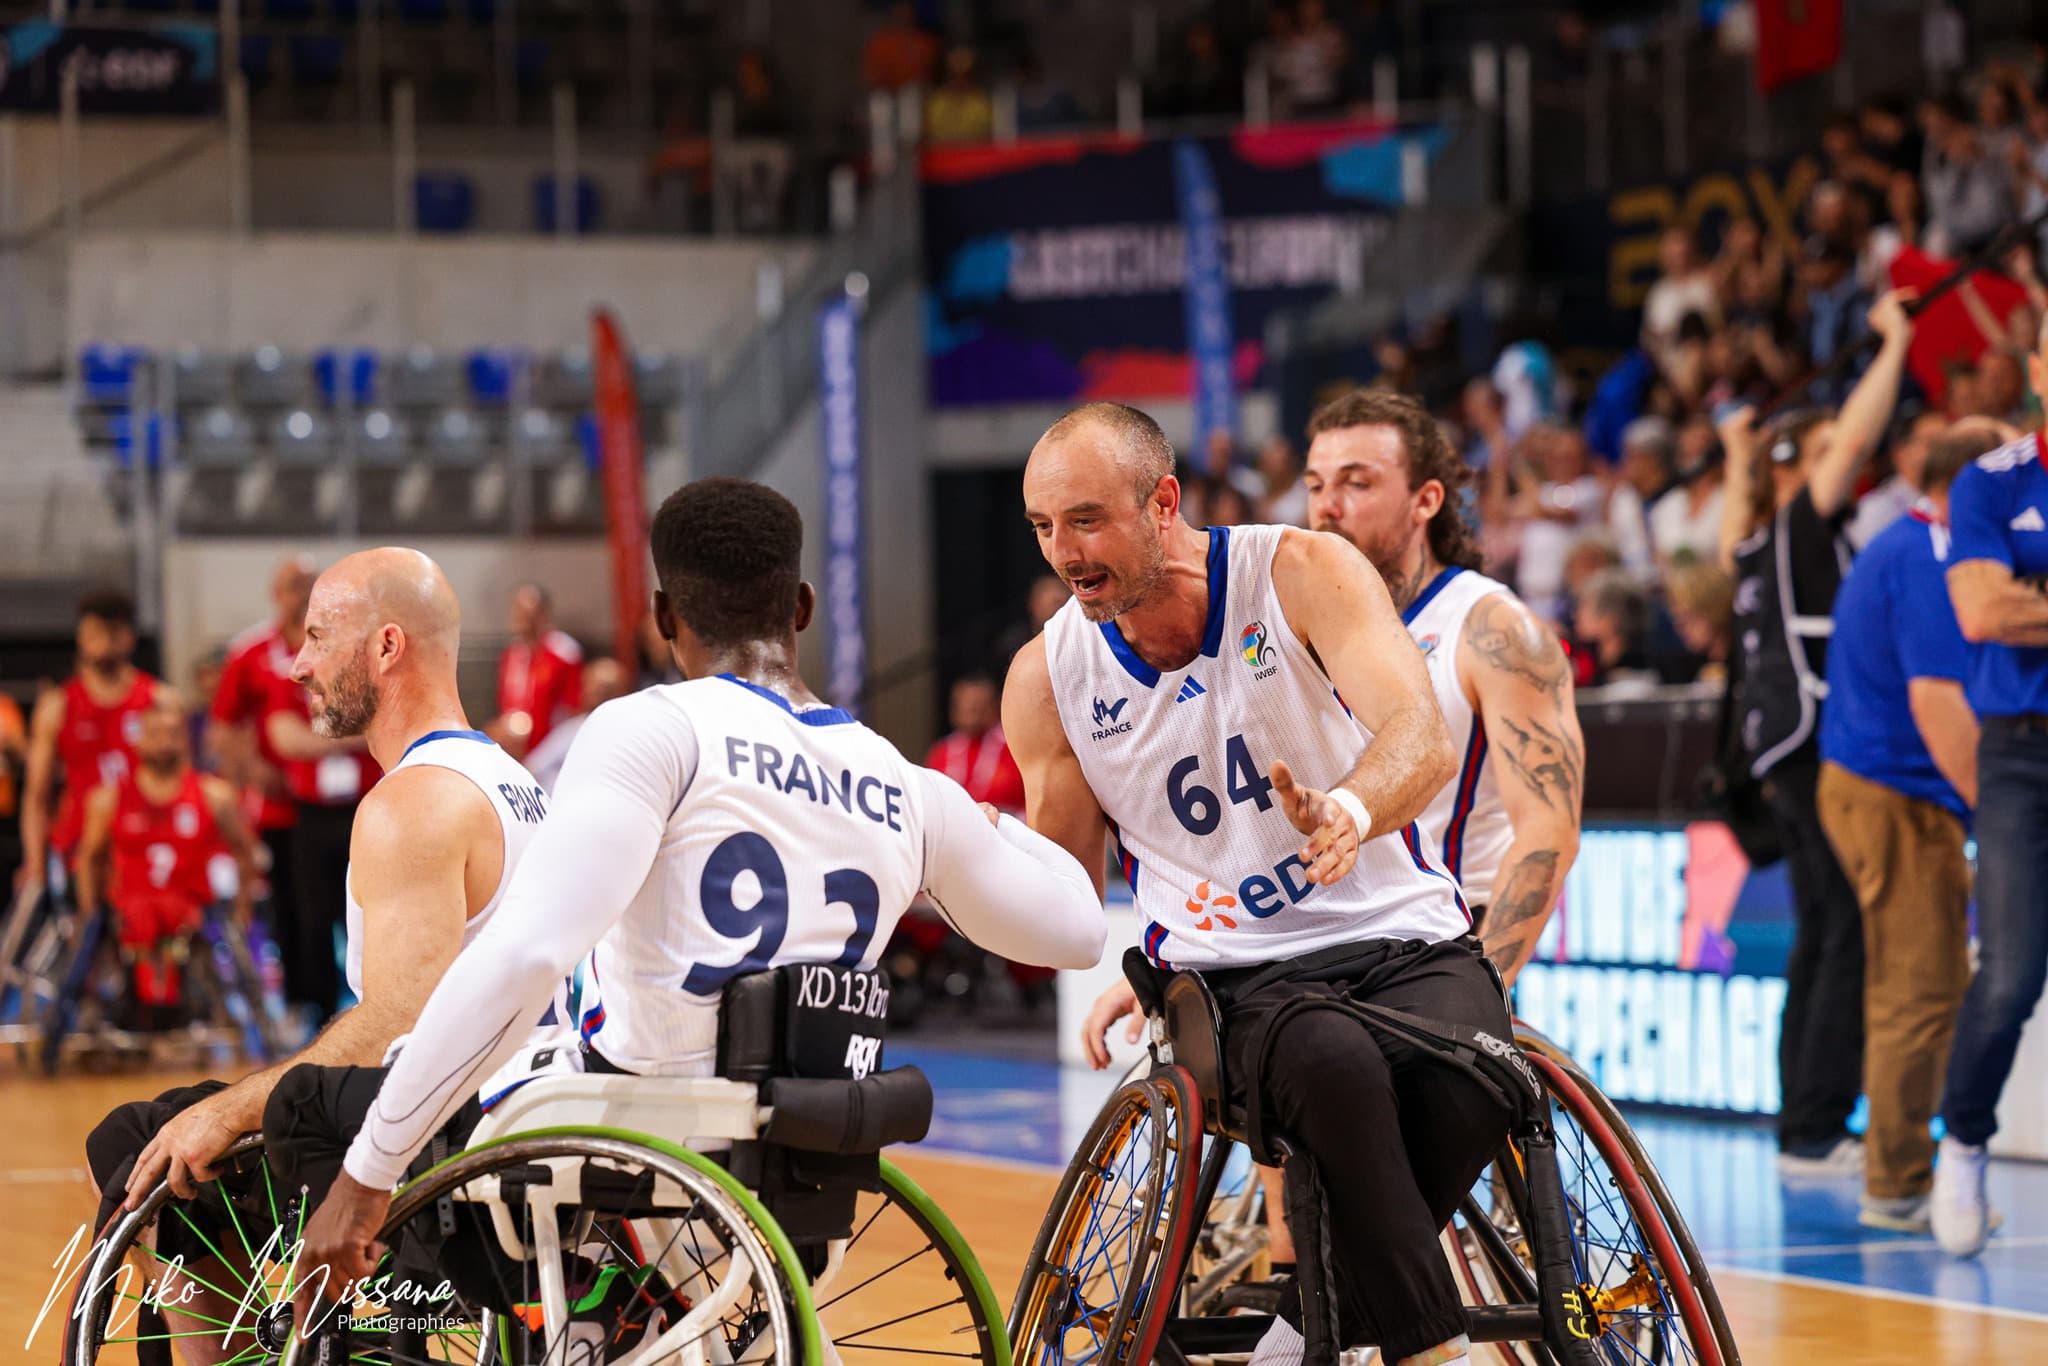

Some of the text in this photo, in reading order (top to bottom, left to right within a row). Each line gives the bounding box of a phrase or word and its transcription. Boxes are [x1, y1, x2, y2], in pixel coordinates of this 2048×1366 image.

[1254, 665, 1278, 681] IWBF
[1091, 721, 1133, 742] FRANCE
[497, 782, 548, 824] FRANC
[725, 735, 903, 833] FRANCE
[1167, 733, 1274, 836] 64
[1238, 851, 1323, 919] eD
[797, 965, 836, 1009] KD
[838, 970, 868, 1015] 13
